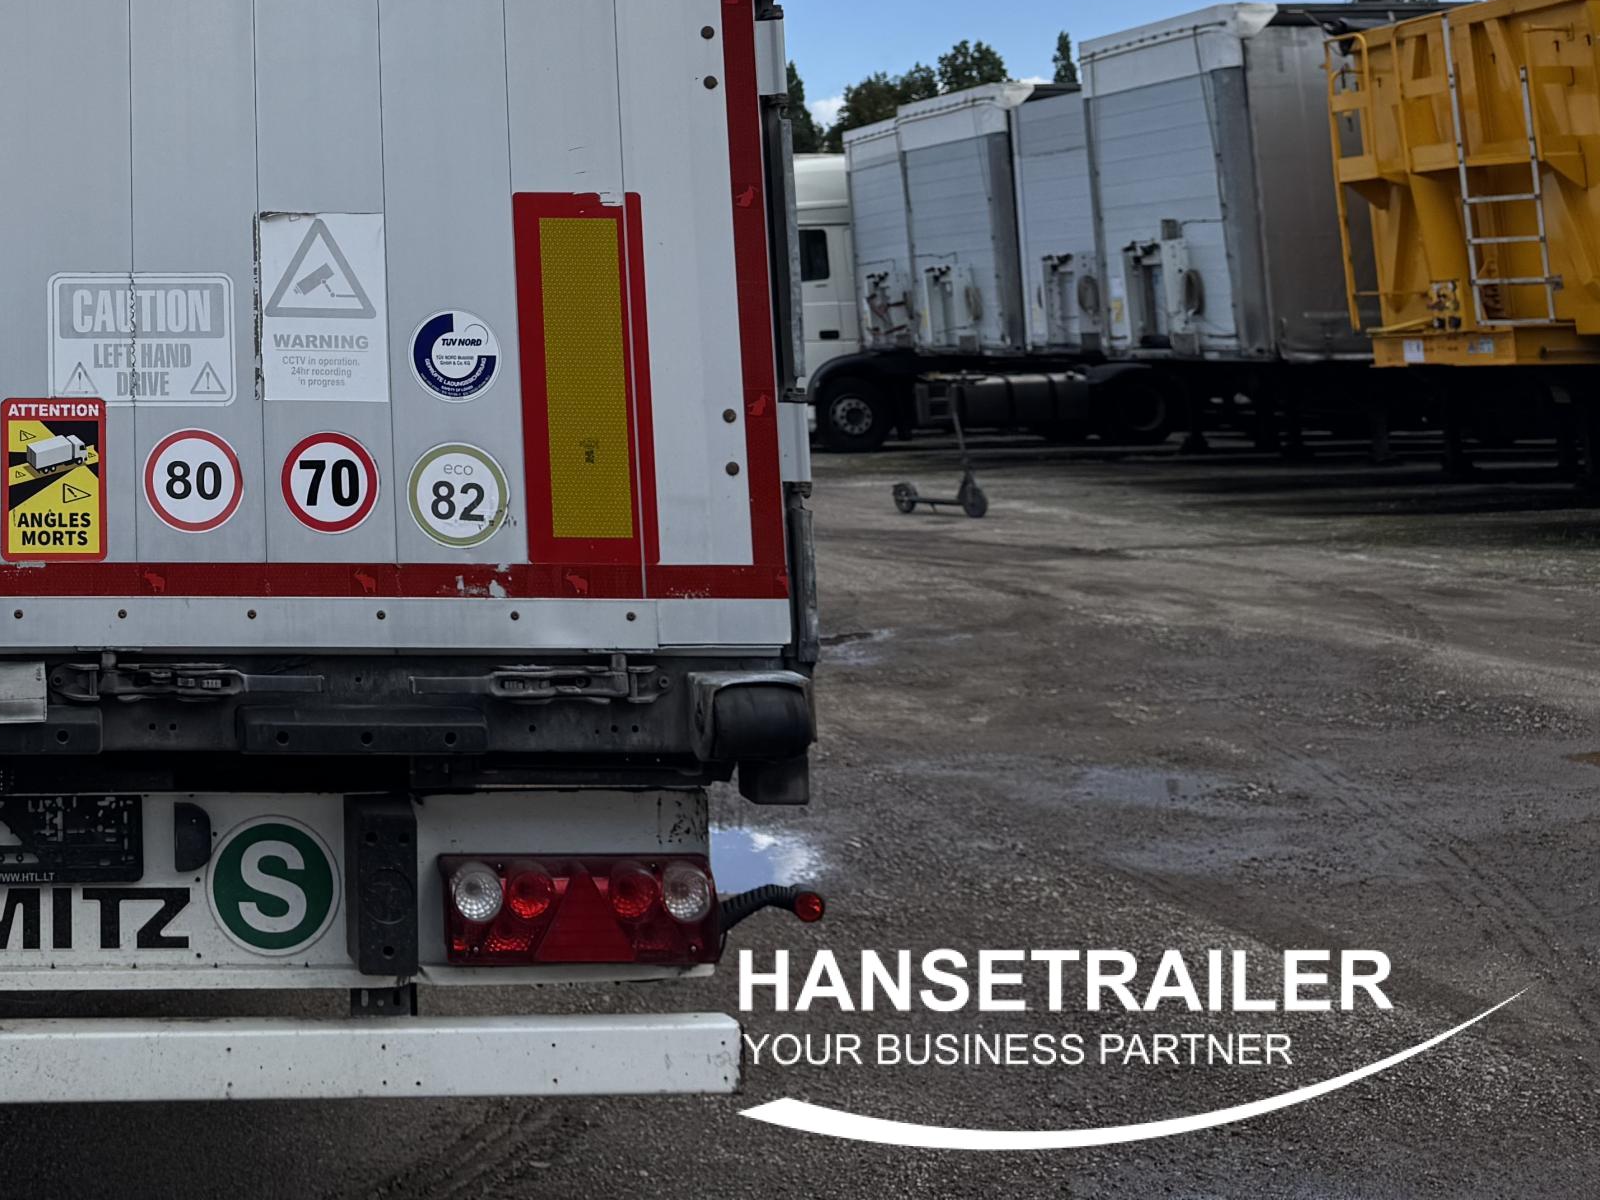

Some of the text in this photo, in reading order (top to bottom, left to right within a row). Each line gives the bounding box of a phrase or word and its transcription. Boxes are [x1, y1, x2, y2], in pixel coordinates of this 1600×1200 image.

[72, 289, 212, 333] CAUTION
[273, 334, 369, 349] WARNING
[458, 338, 482, 346] NORD
[93, 343, 191, 368] LEFT HAND
[282, 356, 306, 365] CCTV
[308, 356, 316, 365] in
[291, 367, 352, 378] 24hr recording
[117, 372, 170, 396] DRIVE
[8, 404, 99, 417] ATTENTION
[443, 464, 474, 476] eco
[165, 460, 222, 500] 80
[299, 459, 360, 507] 70
[431, 480, 484, 521] 82
[17, 512, 91, 528] ANGLES
[22, 530, 88, 546] MORTS
[237, 840, 307, 933] S
